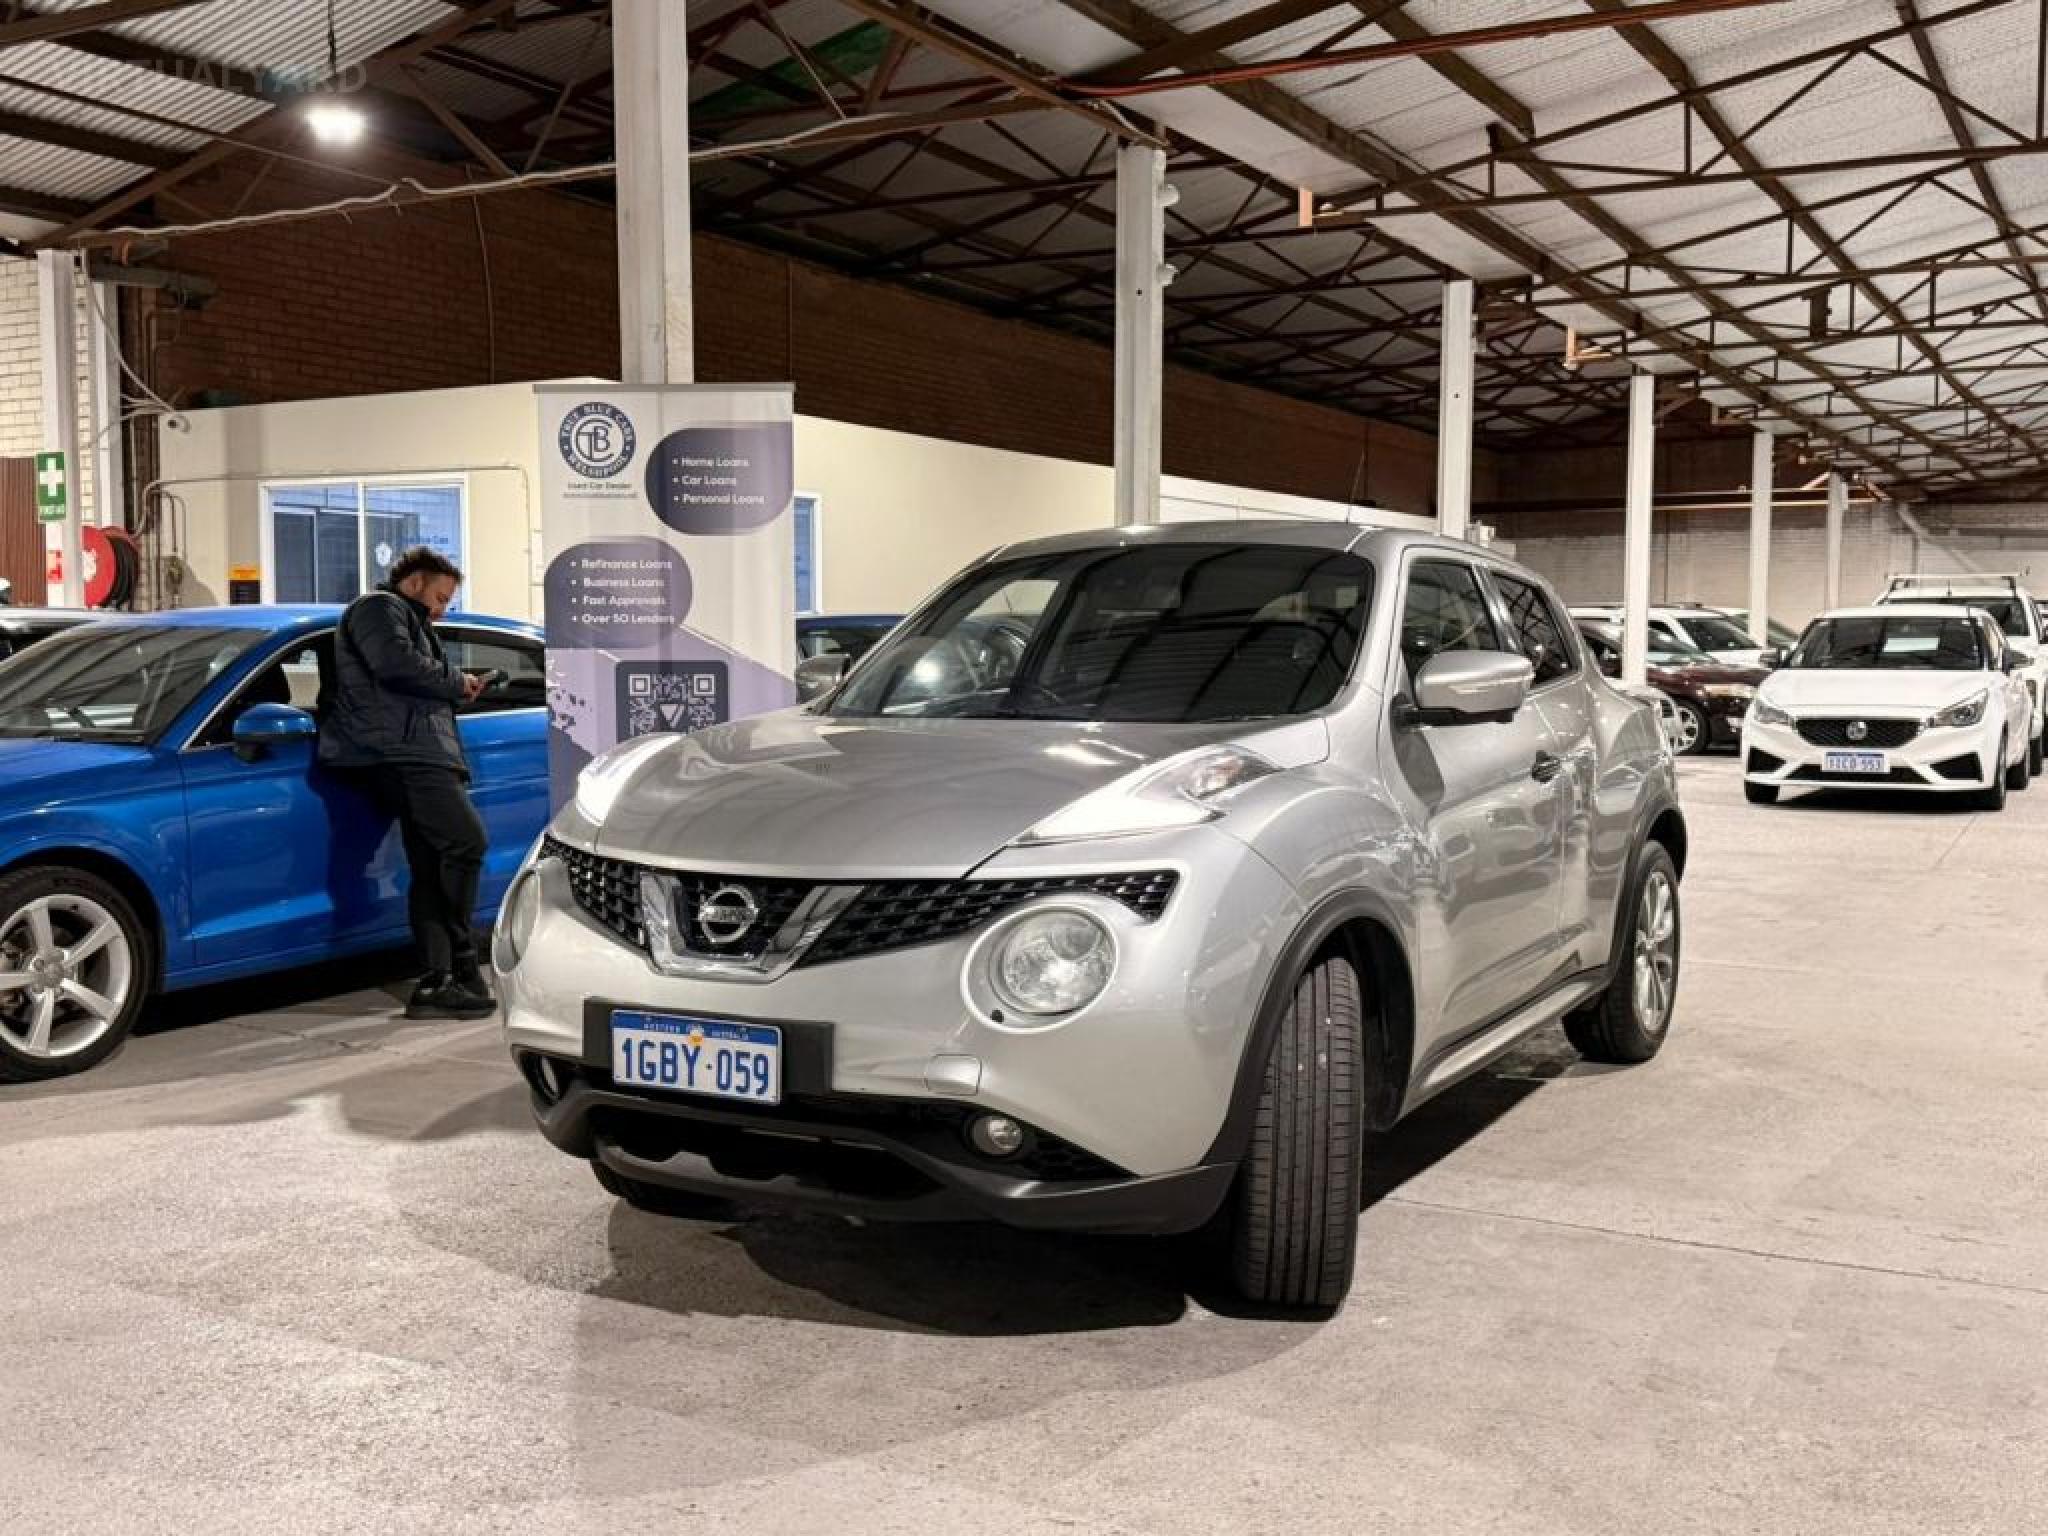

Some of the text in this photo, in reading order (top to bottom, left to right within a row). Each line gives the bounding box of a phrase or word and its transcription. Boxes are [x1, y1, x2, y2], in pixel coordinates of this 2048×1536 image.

[682, 457, 750, 467] Home Loans
[682, 476, 736, 486] Car Loans
[683, 494, 765, 505] Personal Loans
[582, 559, 673, 569] Refinance Loans
[583, 577, 664, 587] Business Loans
[583, 595, 665, 607] Fast Approvals
[582, 613, 609, 623] Over
[631, 613, 675, 624] Lenders
